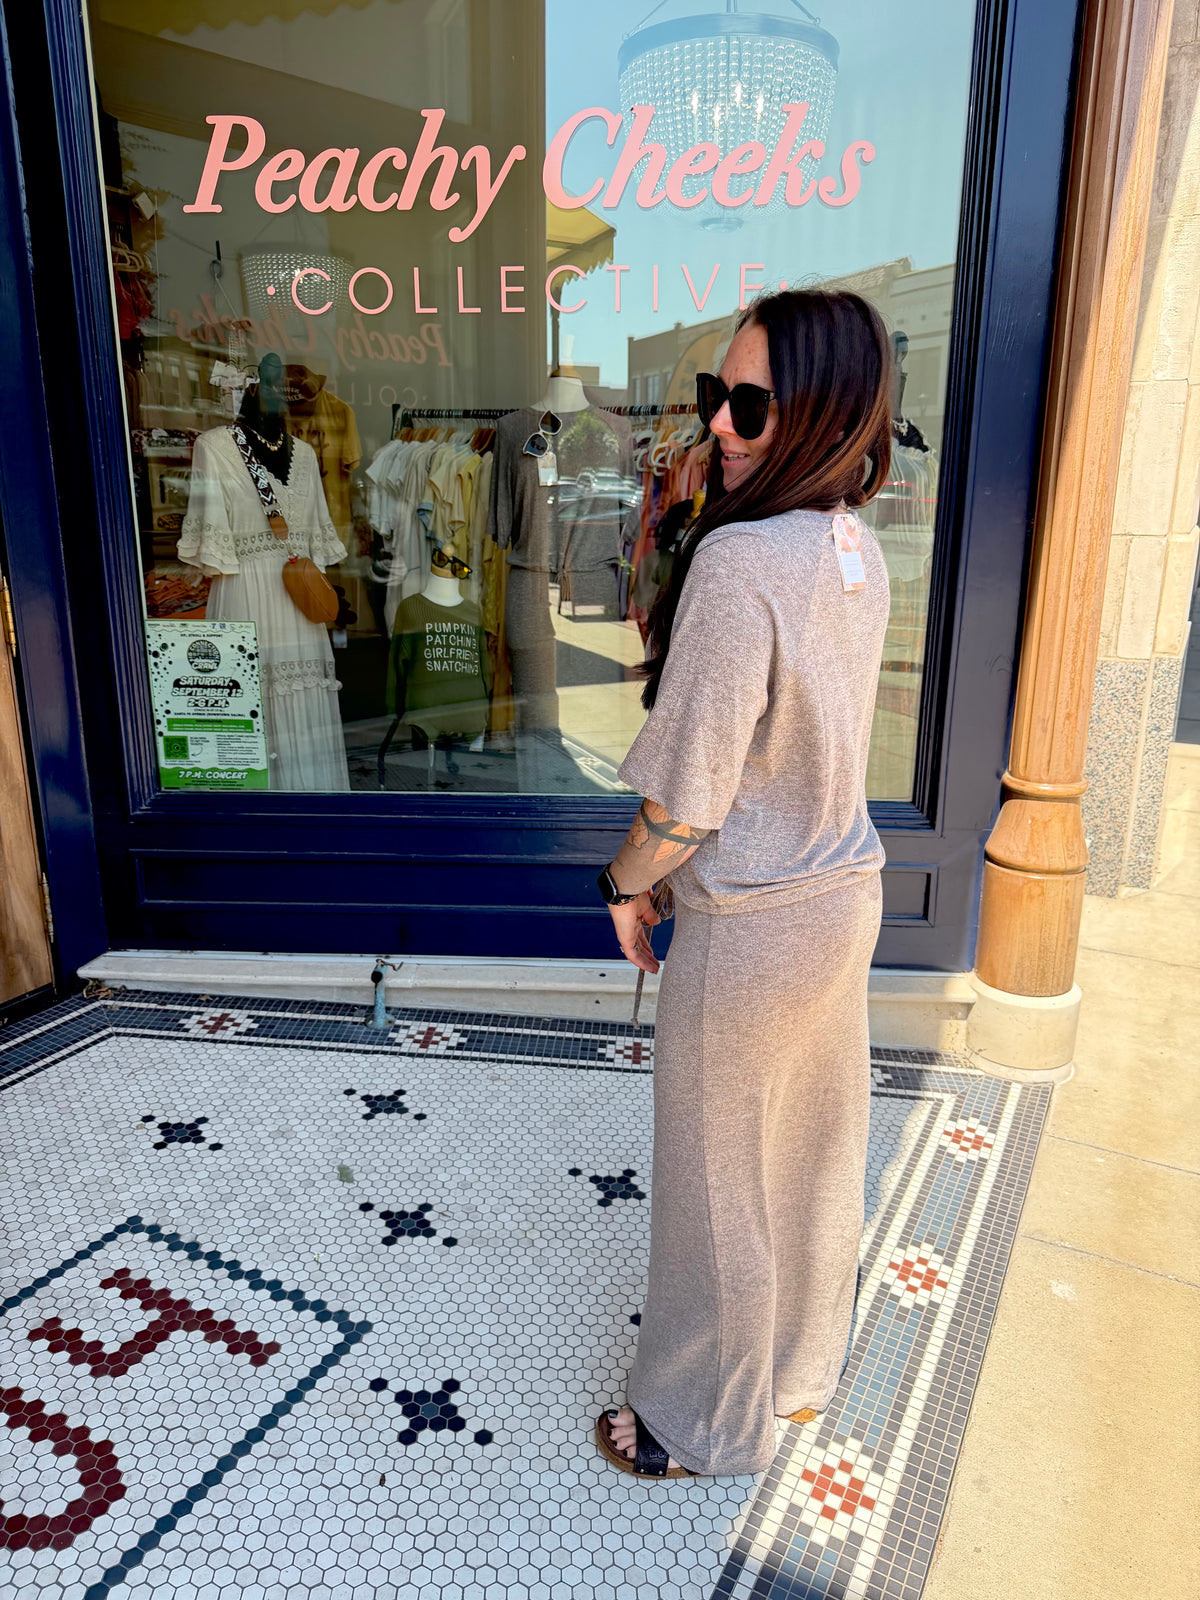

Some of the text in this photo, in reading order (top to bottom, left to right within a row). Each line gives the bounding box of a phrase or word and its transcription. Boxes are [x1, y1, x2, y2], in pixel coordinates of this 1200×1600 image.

[183, 102, 876, 243] Peachy Cheeks
[291, 264, 765, 315] COLLECTIVE
[425, 622, 476, 635] PUMPKIN
[426, 634, 477, 649] PATCHING
[426, 660, 479, 675] SNATCHING
[172, 687, 243, 697] SEPTEMBER 12
[207, 699, 229, 708] P.M.
[205, 771, 248, 779] CONCERT
